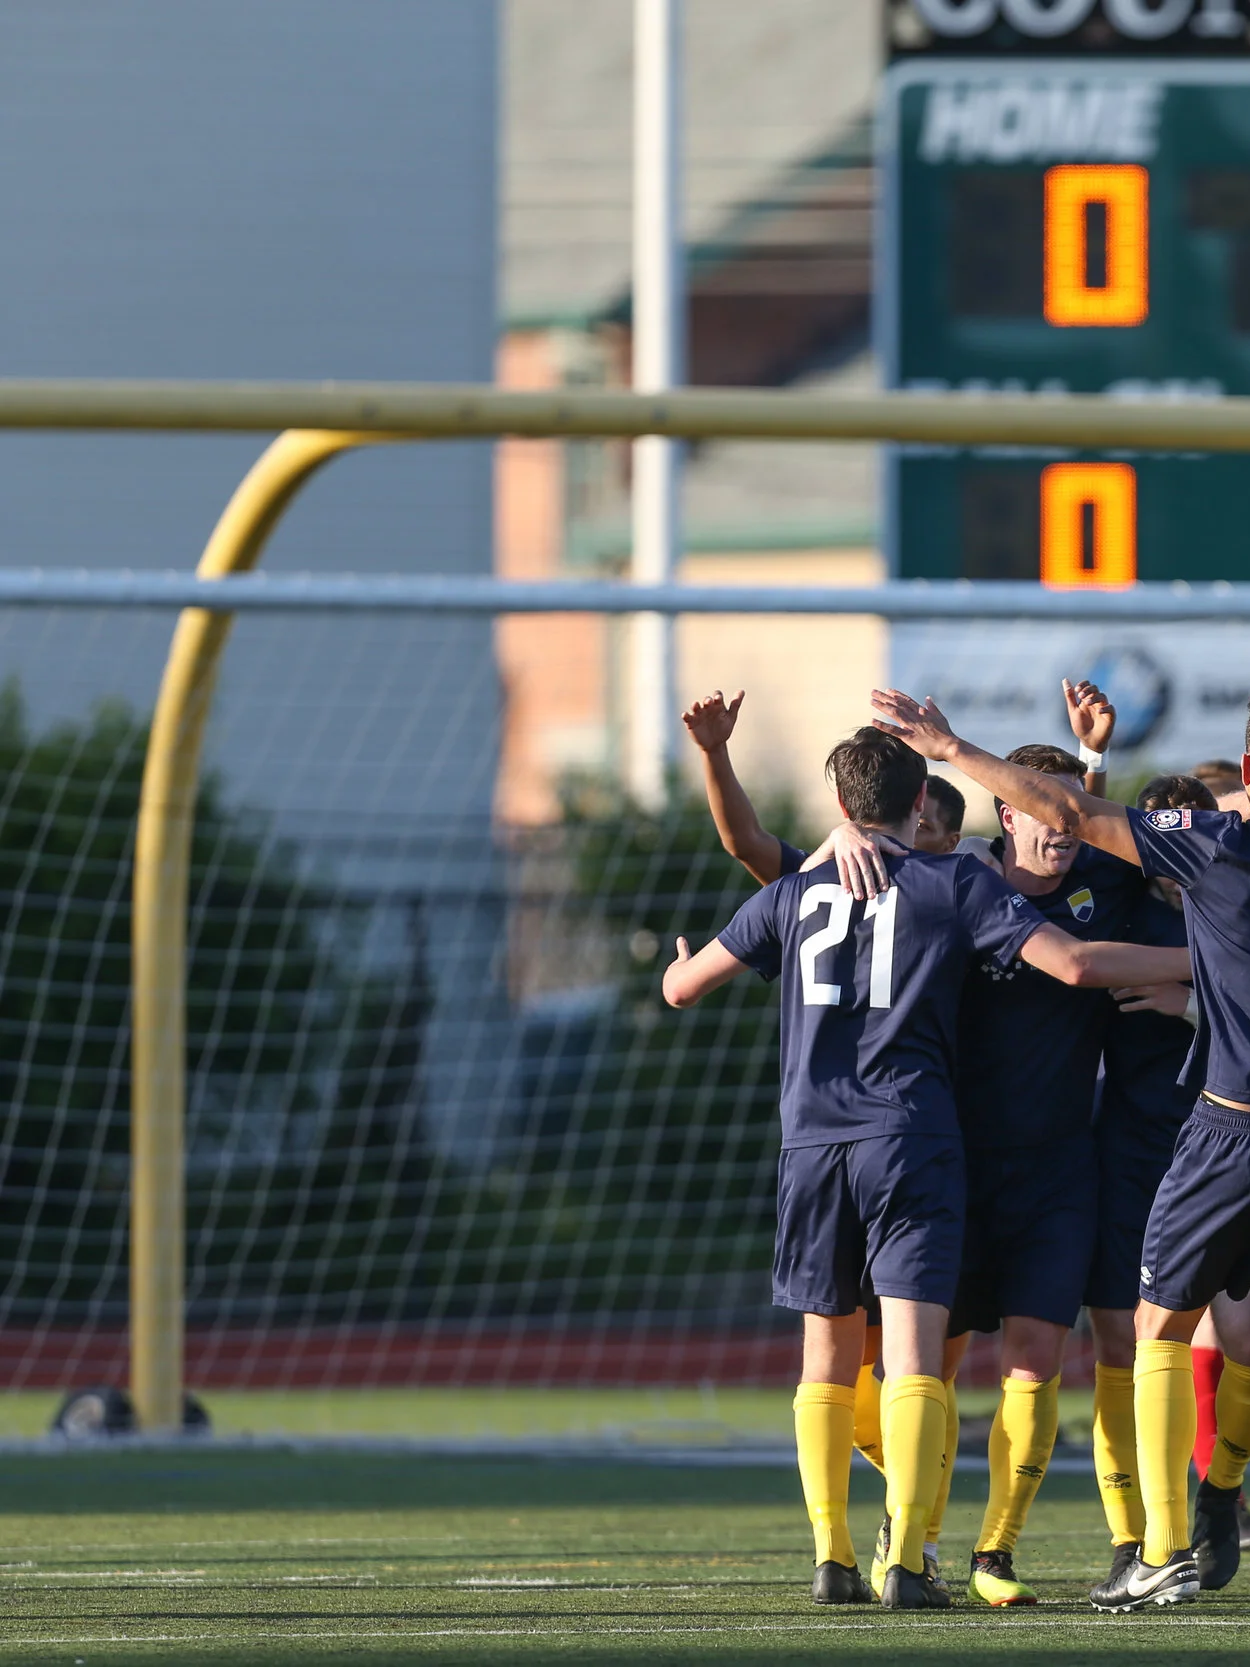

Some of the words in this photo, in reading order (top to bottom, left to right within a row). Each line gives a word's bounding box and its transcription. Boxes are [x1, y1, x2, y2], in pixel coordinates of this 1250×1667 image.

[919, 80, 1161, 164] HOME
[1043, 164, 1149, 327] 0
[1040, 462, 1137, 590] 0
[798, 882, 898, 1009] 21
